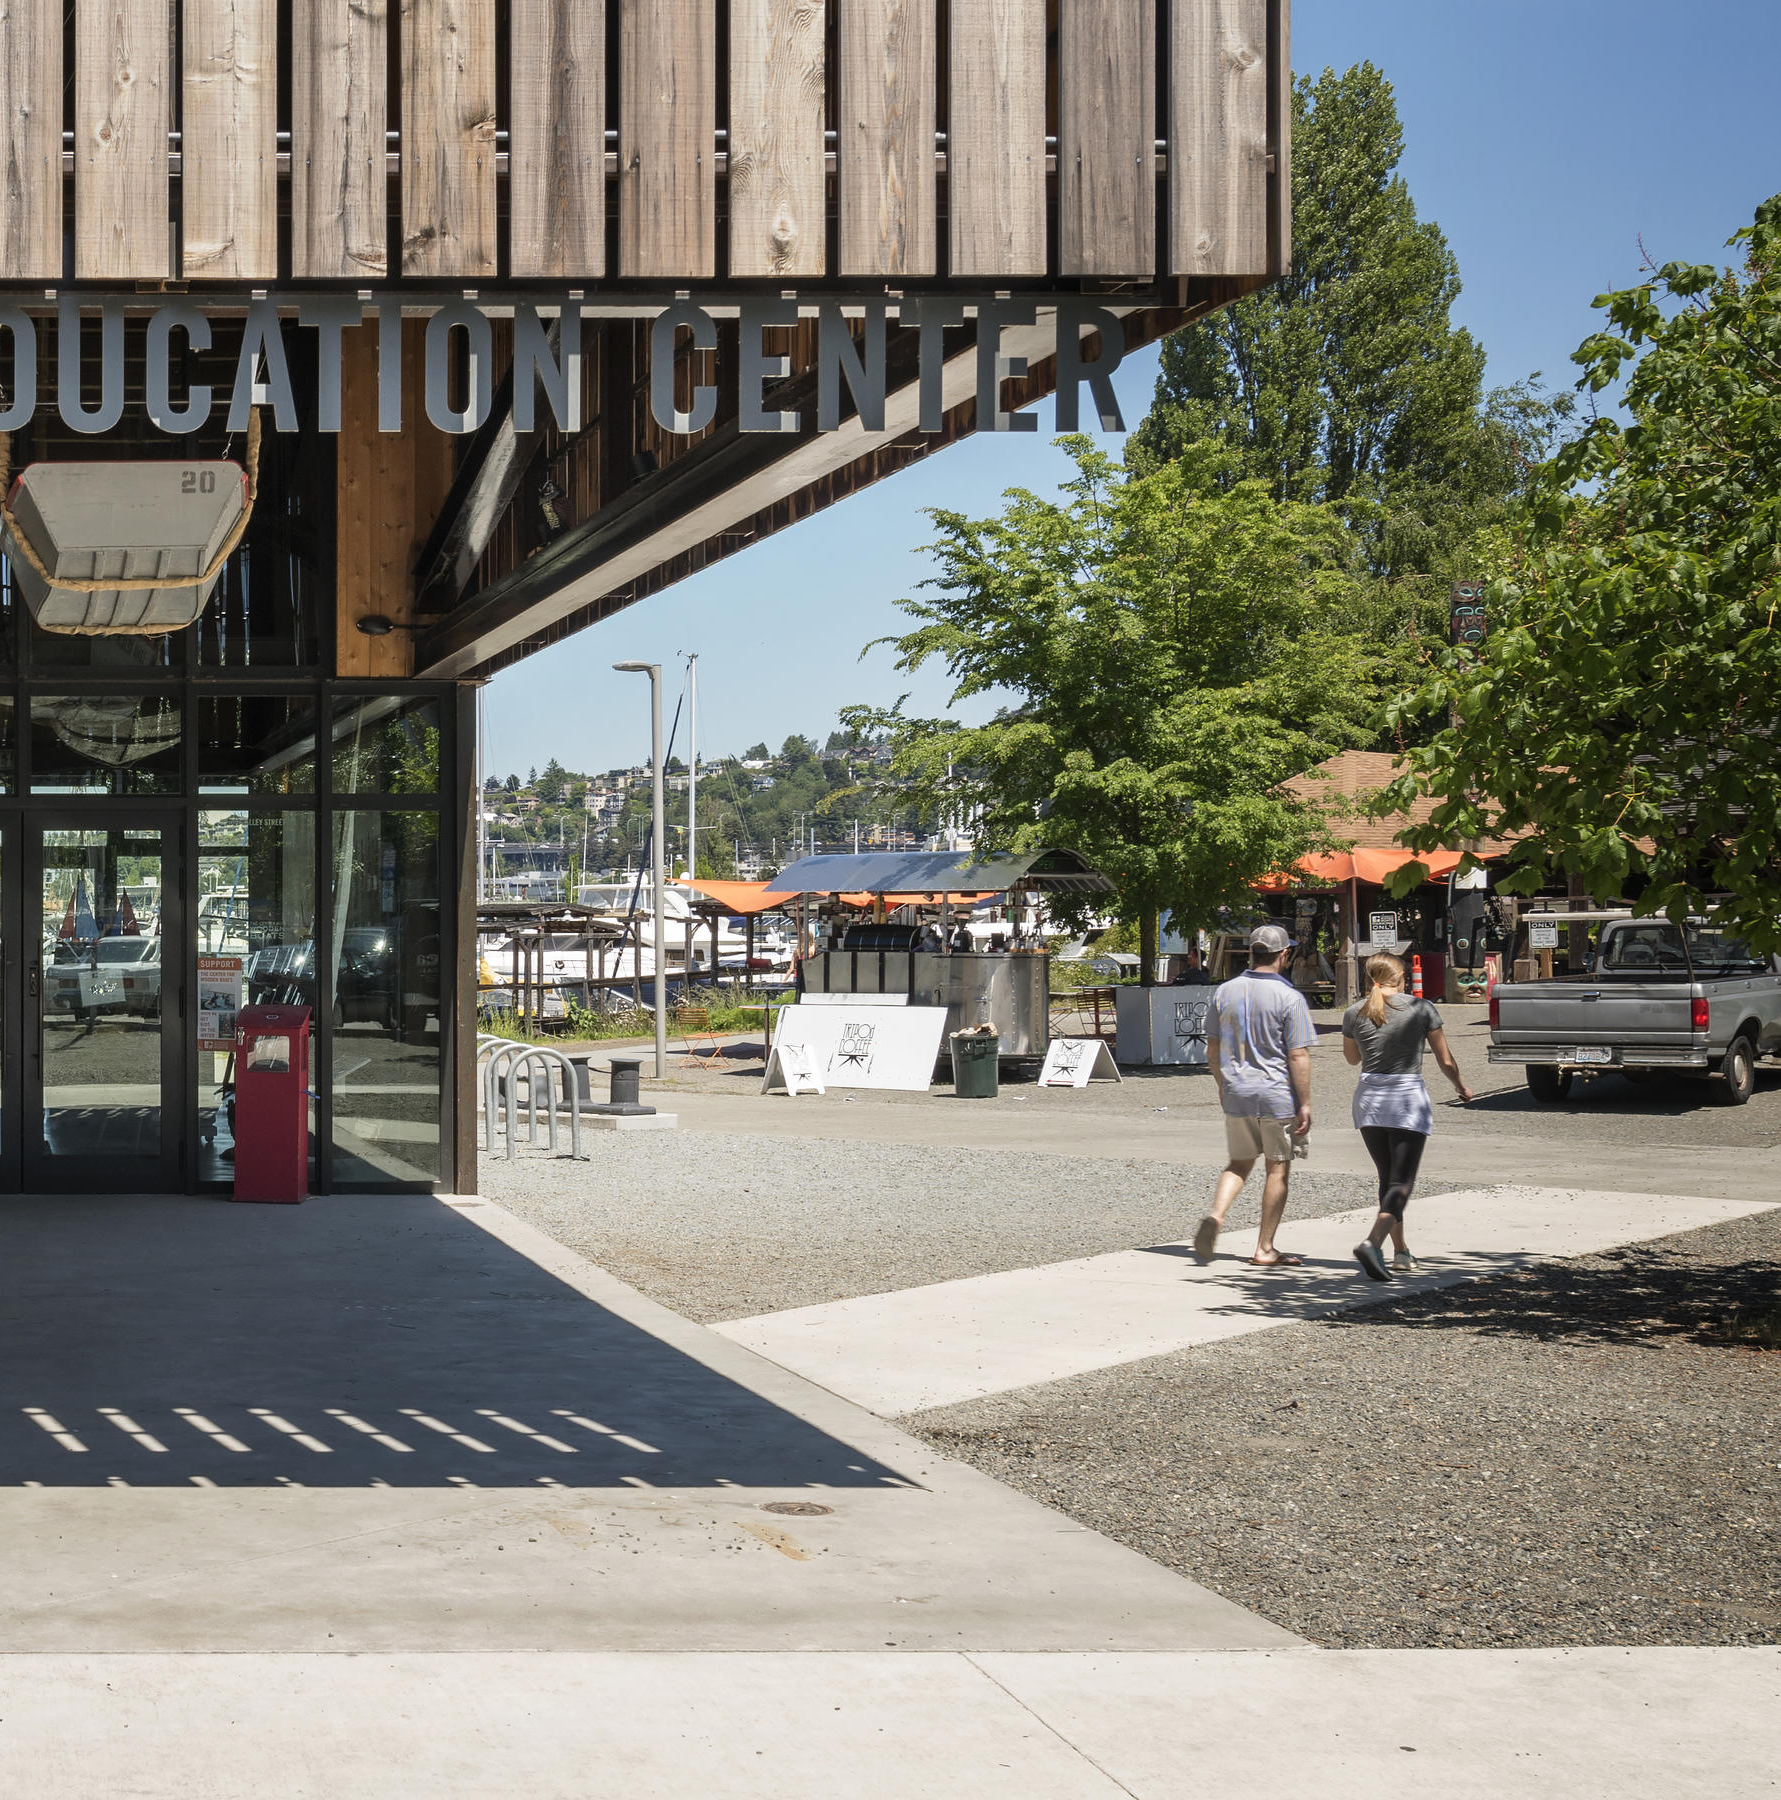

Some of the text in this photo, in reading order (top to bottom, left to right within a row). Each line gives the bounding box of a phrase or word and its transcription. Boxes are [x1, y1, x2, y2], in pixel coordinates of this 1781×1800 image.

[650, 300, 1126, 434] CENTER
[180, 470, 216, 494] 20
[264, 818, 284, 826] STREE
[200, 960, 235, 968] SUPPORT
[1174, 1001, 1209, 1018] TRIPO
